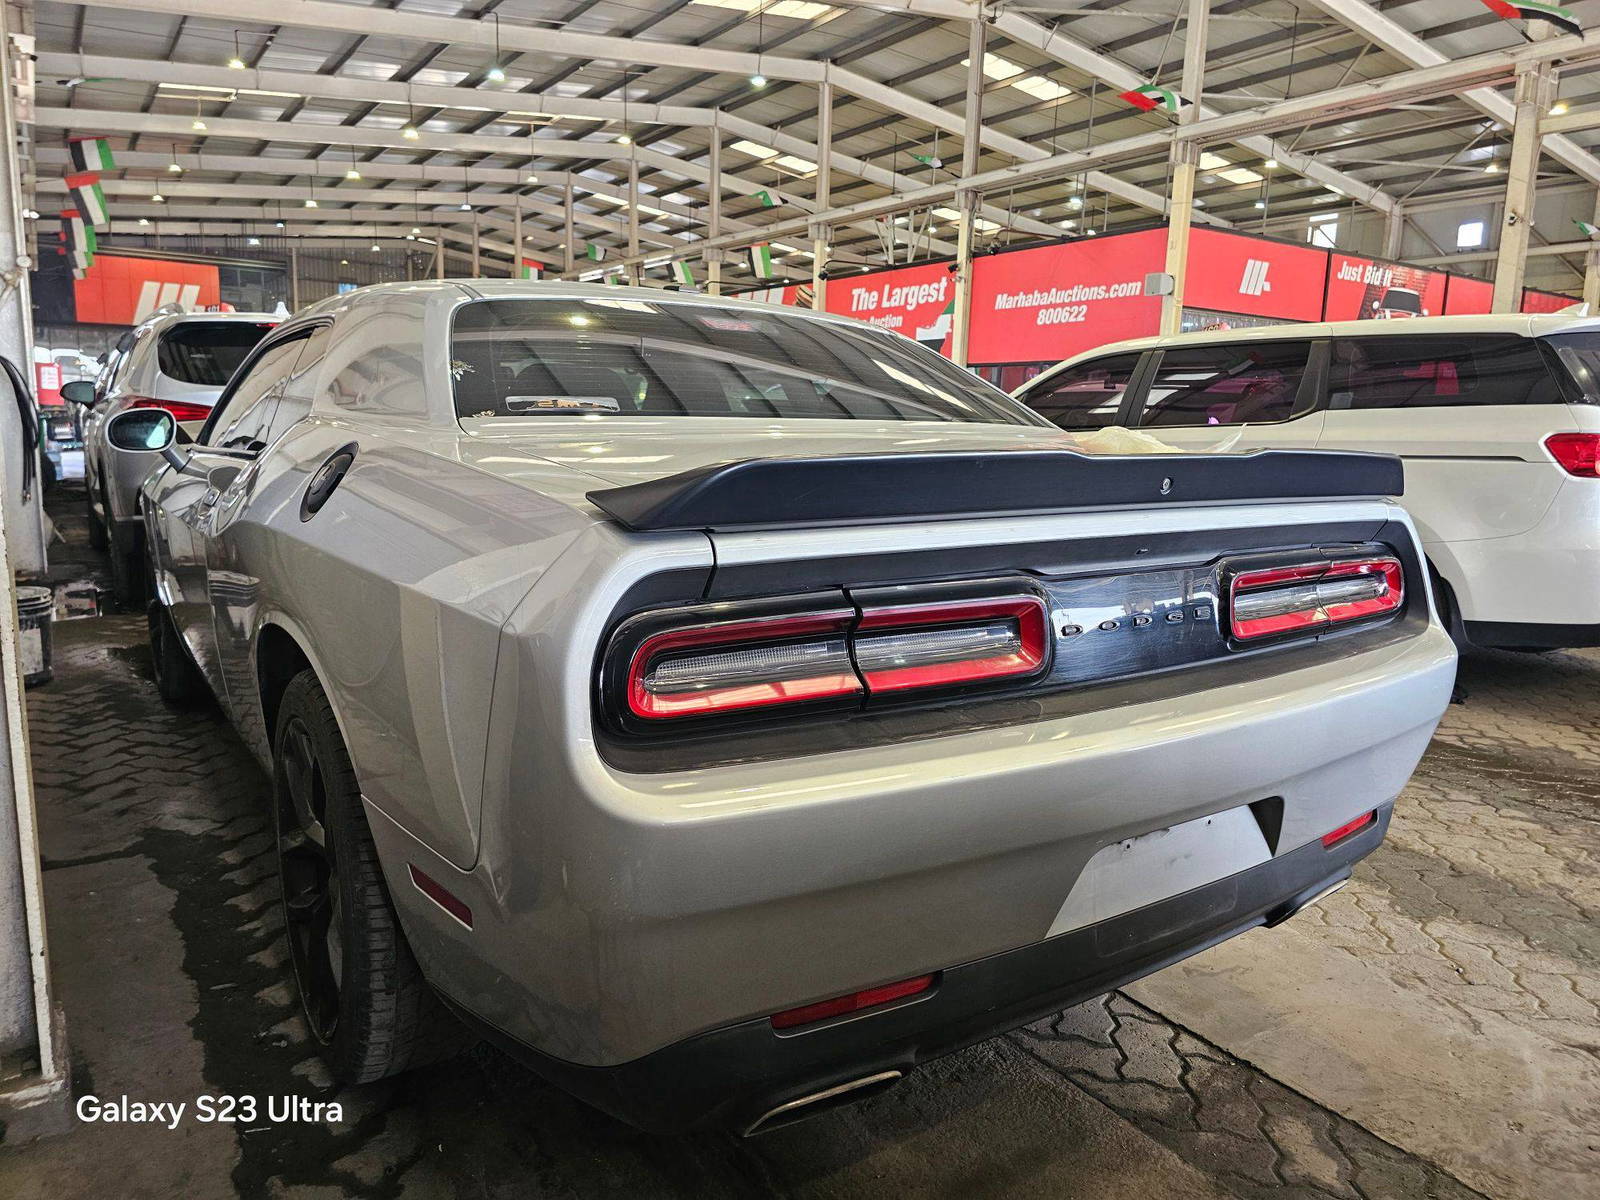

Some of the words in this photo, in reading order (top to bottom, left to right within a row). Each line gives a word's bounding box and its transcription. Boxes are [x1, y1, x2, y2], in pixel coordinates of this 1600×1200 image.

[1337, 261, 1363, 282] Just
[1363, 265, 1383, 286] Bid
[1383, 269, 1394, 287] It
[851, 287, 879, 312] The
[881, 276, 947, 311] Largest
[995, 281, 1142, 310] MarhabaAuctions.com
[1036, 304, 1088, 326] 800622
[1060, 605, 1212, 638] DODGE
